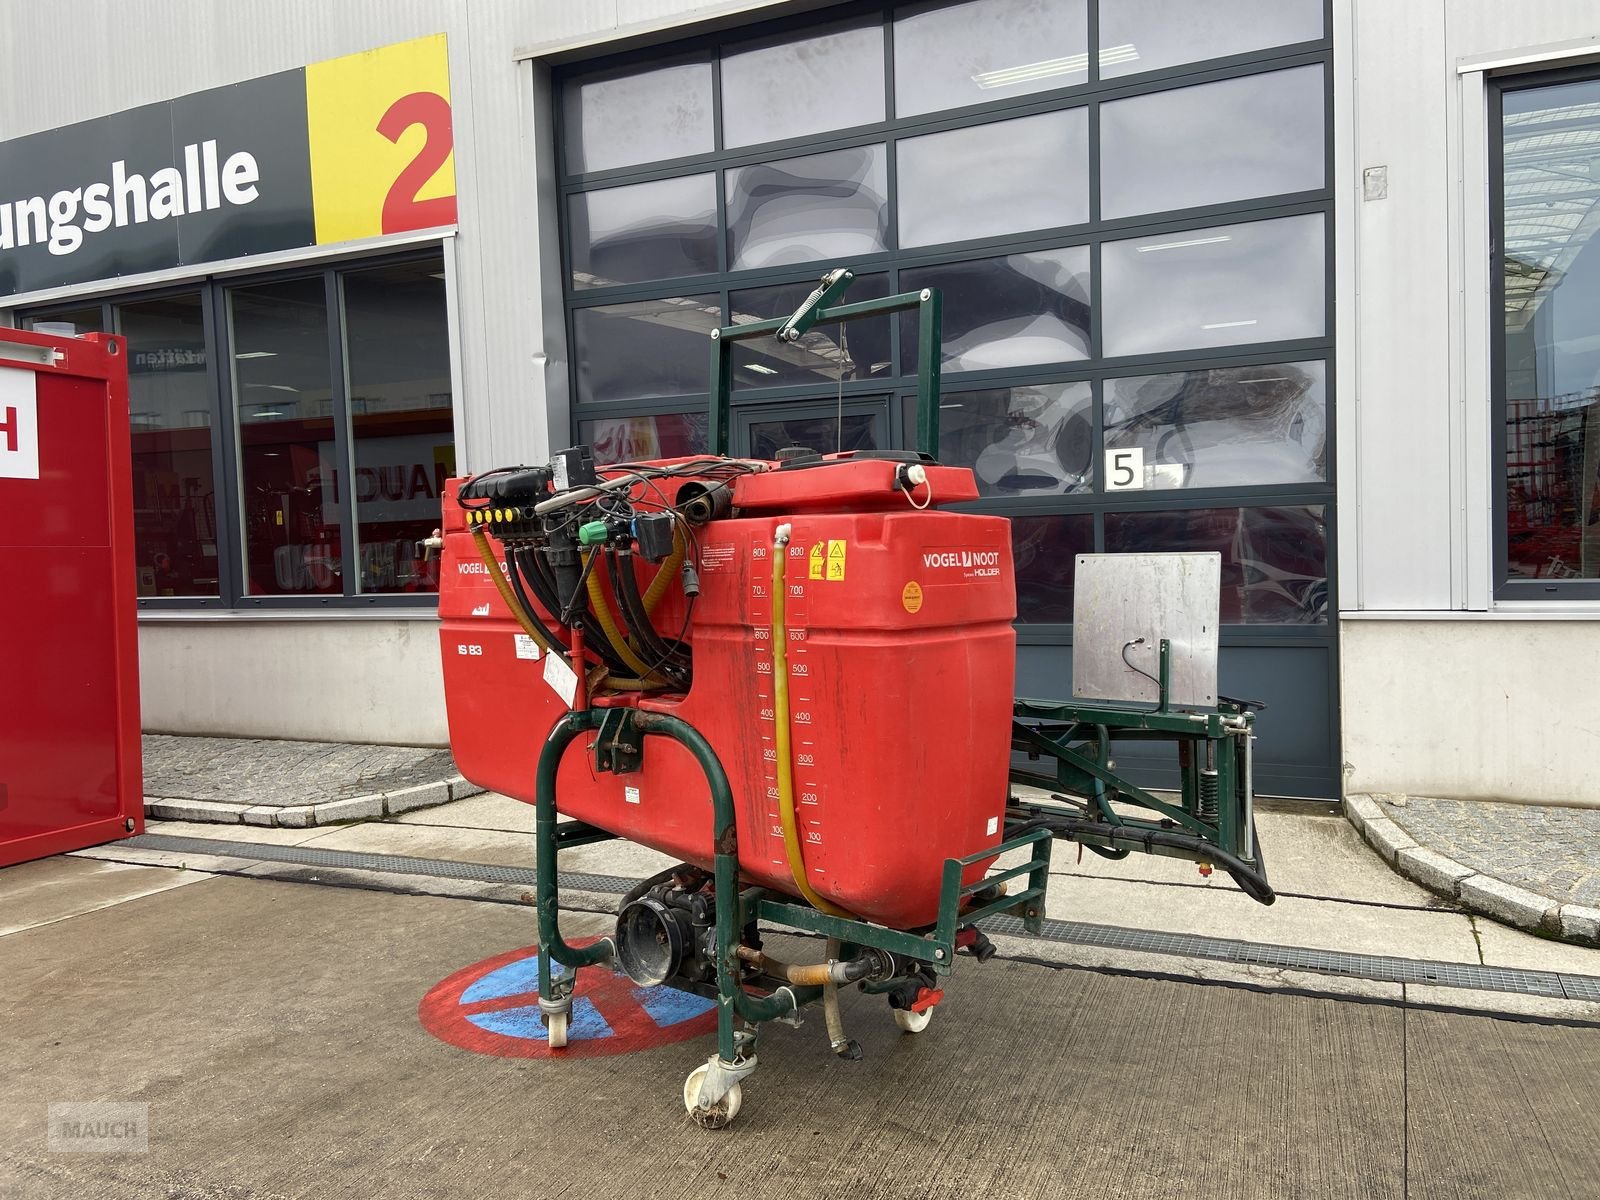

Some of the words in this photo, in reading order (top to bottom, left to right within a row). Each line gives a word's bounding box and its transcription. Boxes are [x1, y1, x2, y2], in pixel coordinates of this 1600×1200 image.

[375, 91, 458, 235] 2
[1113, 453, 1134, 486] 5
[790, 547, 804, 556] 800
[923, 553, 962, 568] VOGEL
[973, 552, 999, 566] NOOT
[458, 562, 484, 575] VOGEL
[974, 567, 1000, 577] HOLDER
[789, 585, 803, 595] 700
[755, 631, 769, 640] 600
[790, 632, 804, 640] 600
[468, 645, 482, 655] 83
[757, 662, 770, 671] 500
[792, 664, 807, 673] 500
[760, 709, 774, 717] 400
[795, 712, 810, 721] 400
[764, 748, 776, 758] 300
[798, 754, 813, 763] 300
[802, 793, 817, 802] 200
[808, 832, 821, 840] 100
